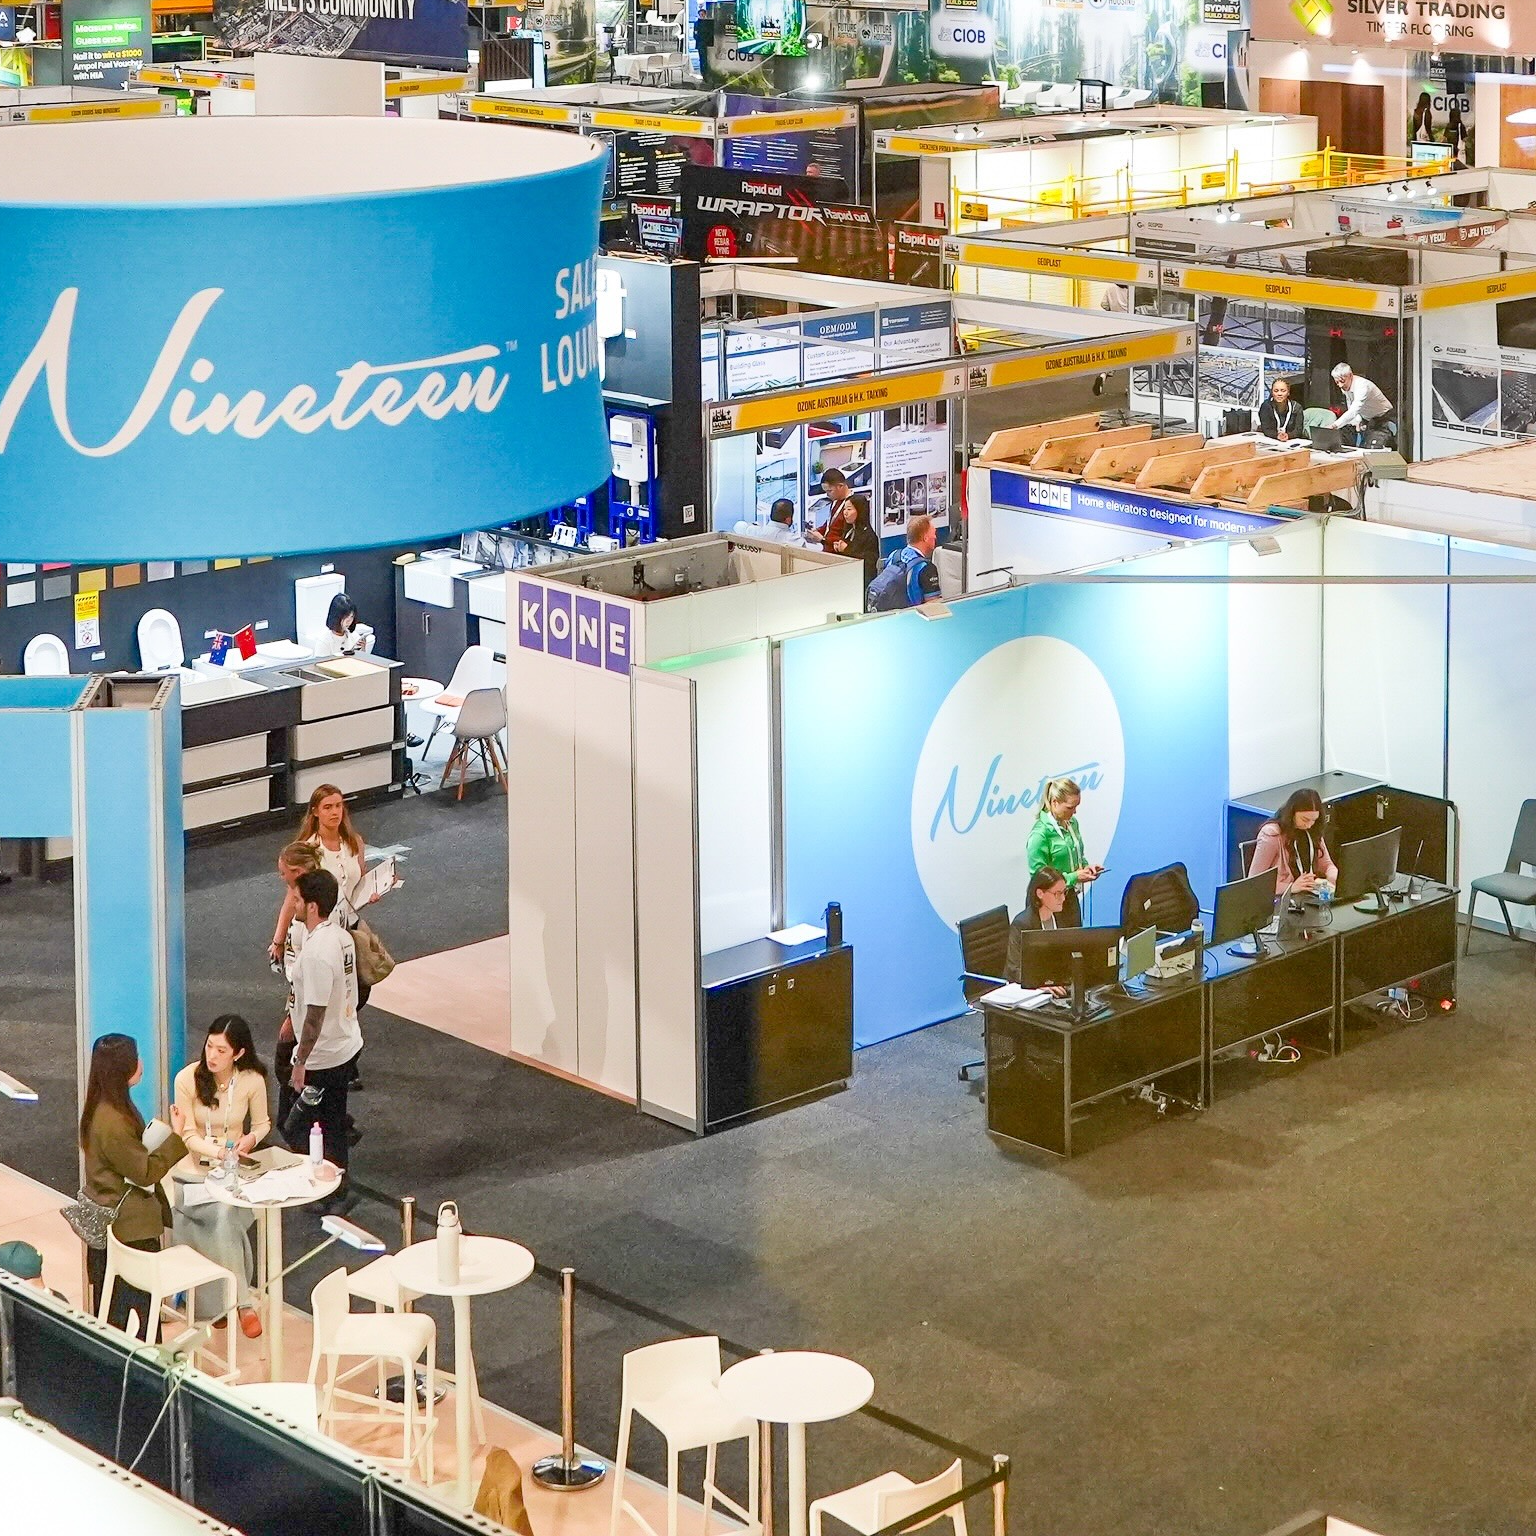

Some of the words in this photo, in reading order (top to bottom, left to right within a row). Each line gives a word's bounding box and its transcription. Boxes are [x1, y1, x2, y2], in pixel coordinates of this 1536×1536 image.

[1204, 3, 1240, 13] SYDNEY
[1416, 0, 1506, 20] TRADING
[75, 24, 113, 33] Measure
[75, 36, 99, 45] Guess
[953, 29, 986, 43] CIOB
[73, 52, 86, 61] Nail
[102, 51, 115, 59] win
[122, 49, 142, 59] $1000
[73, 62, 96, 71] Ampol
[97, 61, 112, 69] Fuel
[73, 71, 88, 80] with
[1433, 95, 1470, 114] CIOB
[742, 181, 767, 196] Rapid
[631, 204, 654, 217] Rapid
[697, 196, 827, 227] WRAPTOR
[825, 208, 853, 222] Rapid
[714, 228, 727, 236] NEW
[714, 237, 730, 245] REBAR
[715, 246, 730, 254] TYING
[1265, 284, 1292, 295] GEOPLAST
[819, 321, 857, 335] OEM/ODM
[1045, 360, 1062, 370] OZONE
[1063, 353, 1091, 368] AUSTRALIA
[954, 375, 960, 385] J5
[797, 399, 816, 412] OZONE
[817, 394, 848, 409] AUSTRALIA
[866, 387, 888, 400] TAIXING
[1030, 487, 1069, 503] KONE
[1077, 494, 1104, 509] Home
[1106, 501, 1148, 517] elevators
[1150, 508, 1193, 525] designed
[1194, 514, 1208, 527] for
[1210, 520, 1246, 534] modern
[522, 599, 626, 656] KONE
